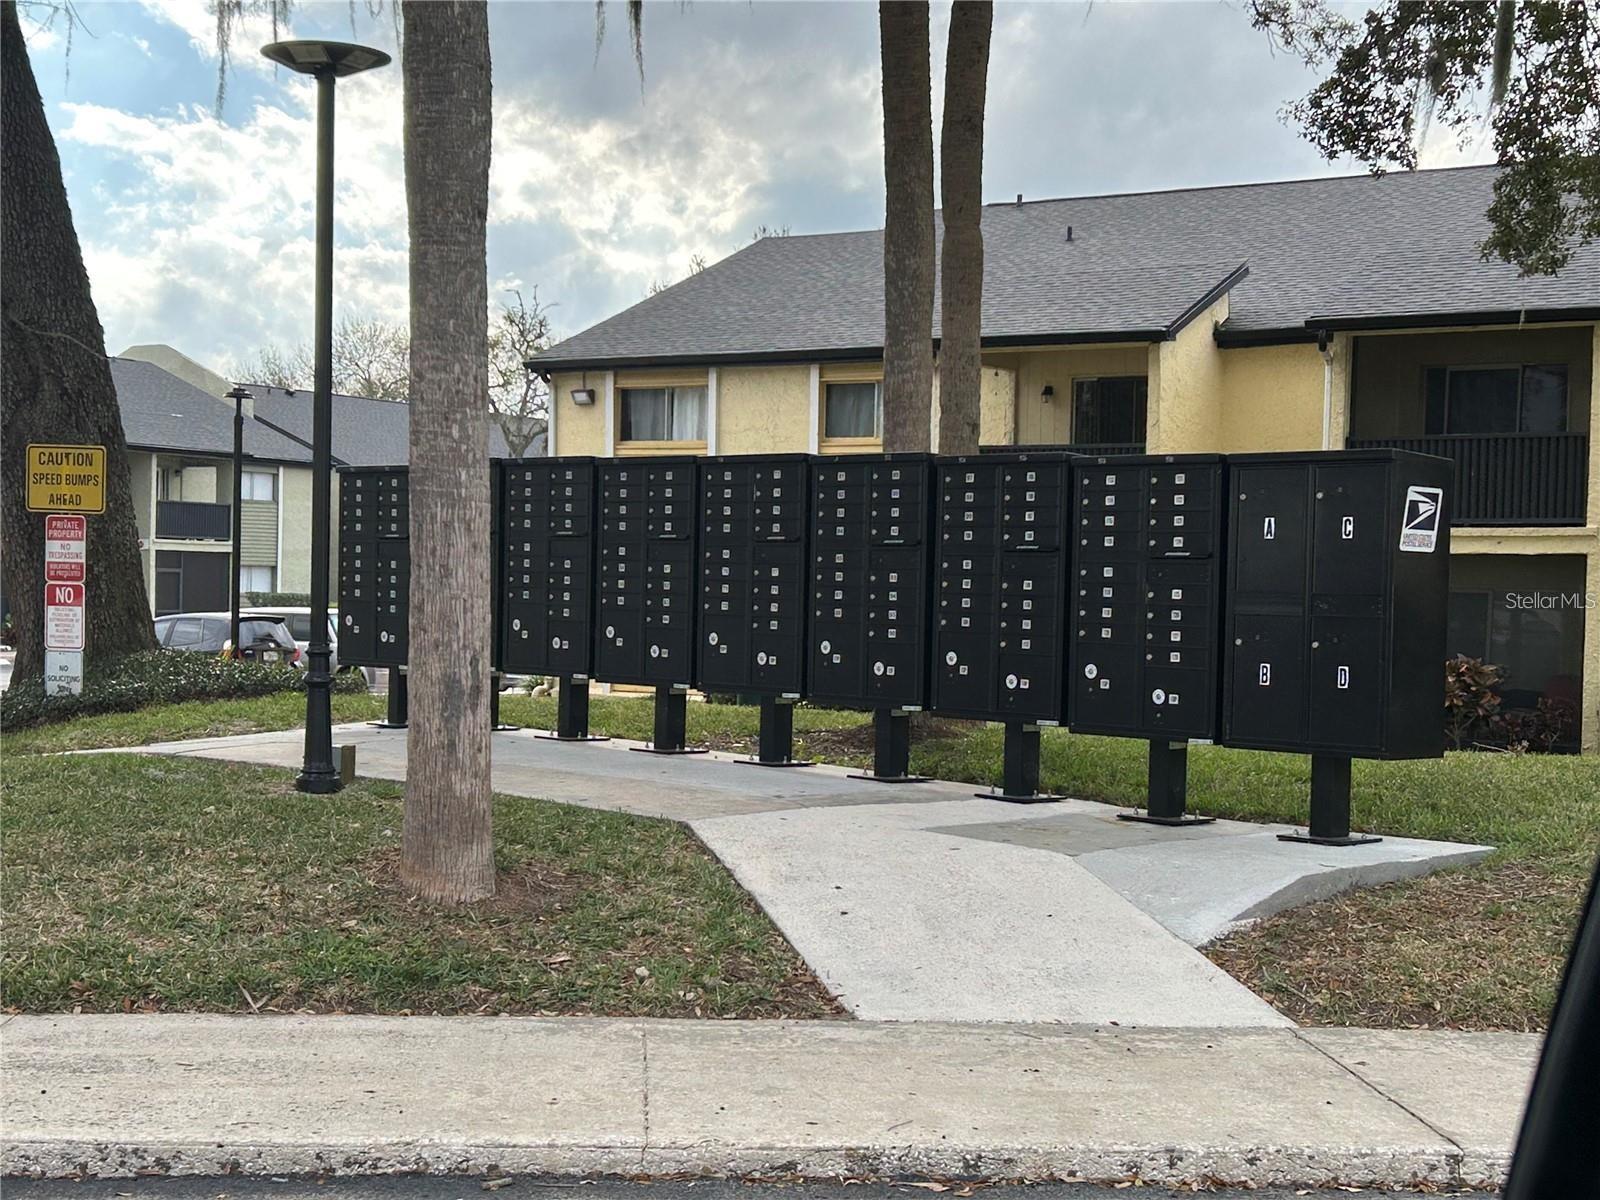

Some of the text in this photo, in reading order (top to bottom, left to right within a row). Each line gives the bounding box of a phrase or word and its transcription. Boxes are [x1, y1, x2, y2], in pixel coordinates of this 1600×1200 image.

[38, 451, 94, 467] CAUTION
[32, 472, 99, 487] SPEED BUMPS
[48, 493, 82, 506] AHEAD
[51, 520, 80, 530] PRIVATE
[1265, 518, 1273, 537] A
[1344, 518, 1352, 537] C
[48, 529, 82, 538] PROPERTY
[60, 543, 71, 551] NO
[48, 551, 83, 560] TRESPASSING
[55, 586, 74, 604] NO
[47, 675, 81, 683] SOLICITING
[1261, 665, 1269, 684] B
[1339, 668, 1348, 687] D
